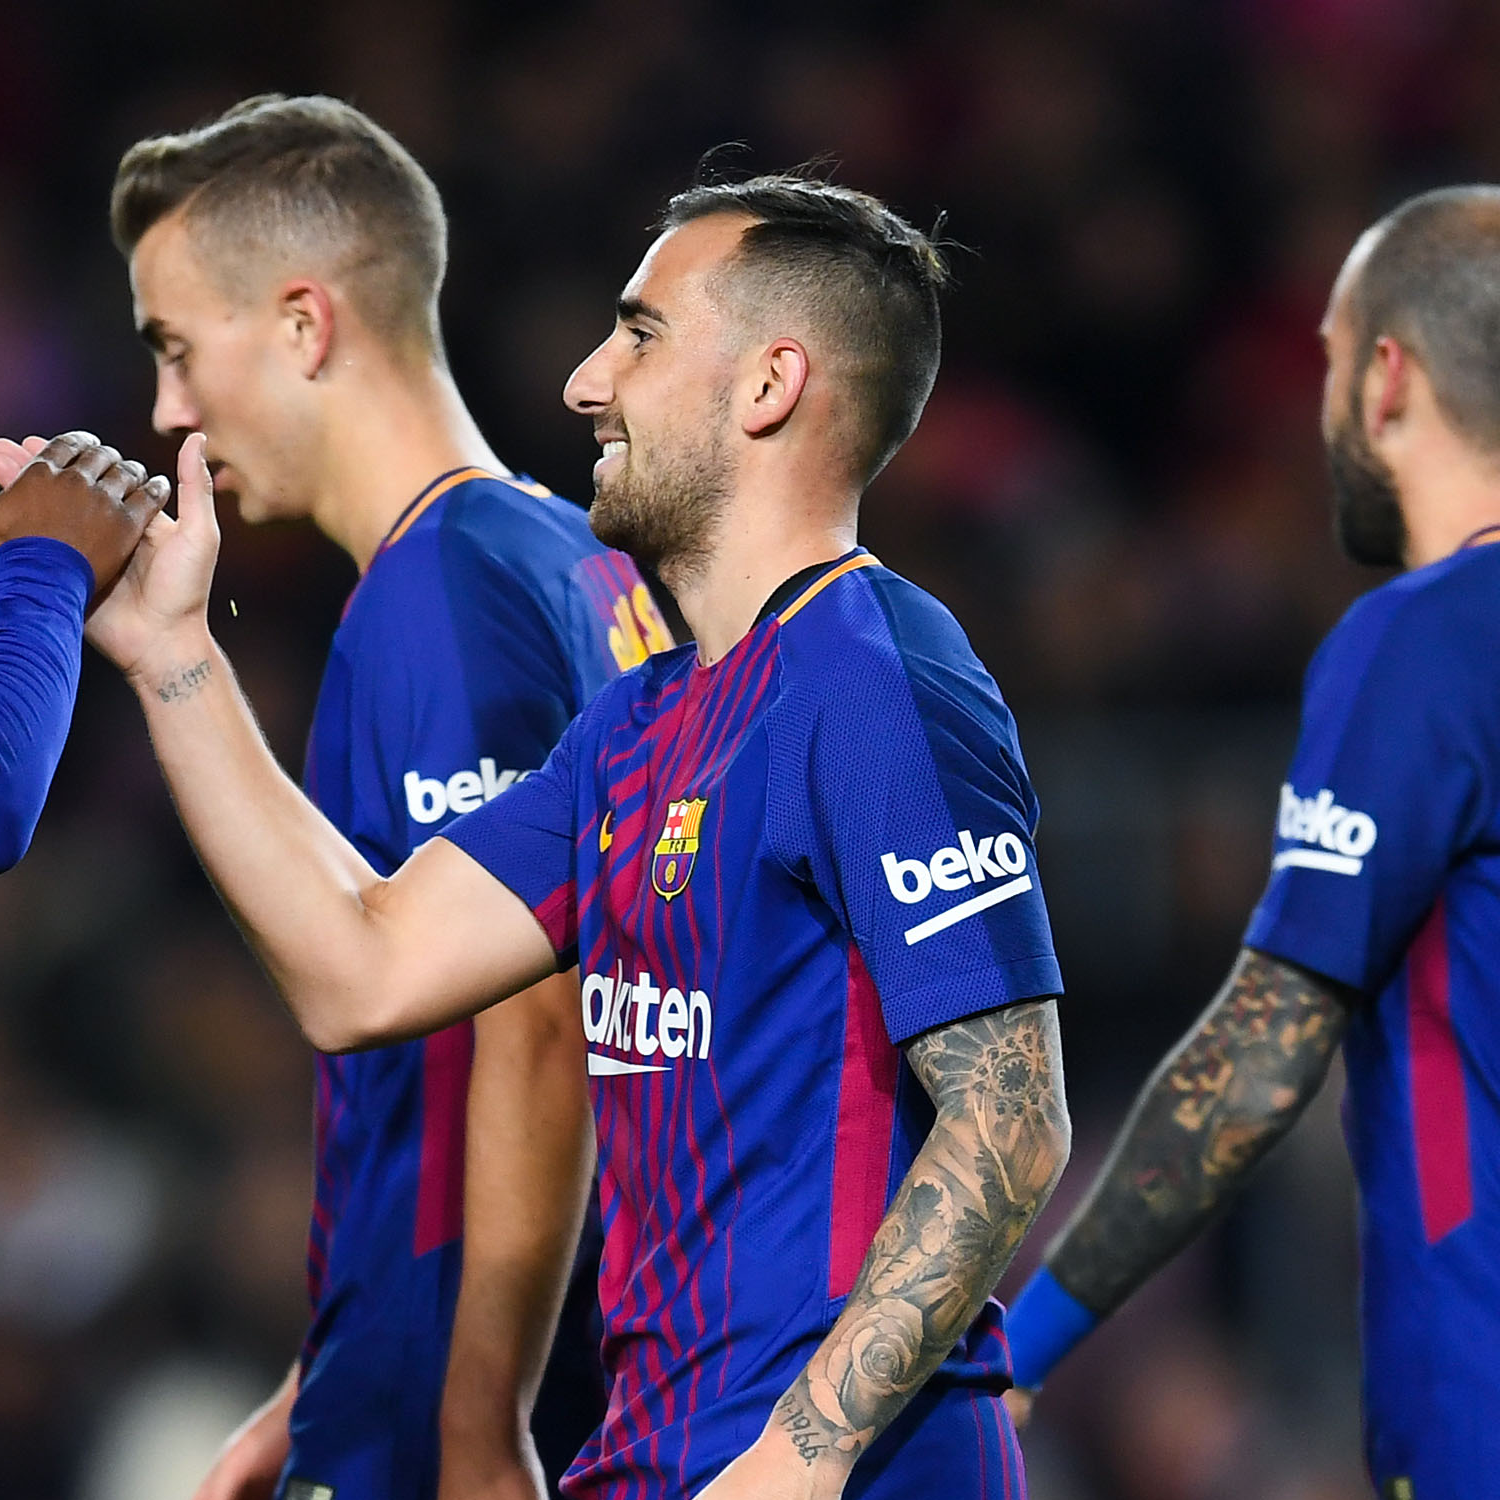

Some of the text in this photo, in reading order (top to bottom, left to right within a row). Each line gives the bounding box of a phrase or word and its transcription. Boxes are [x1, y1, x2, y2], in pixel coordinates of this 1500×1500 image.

[403, 757, 534, 824] bek
[668, 840, 687, 853] FCB
[880, 830, 1027, 904] beko
